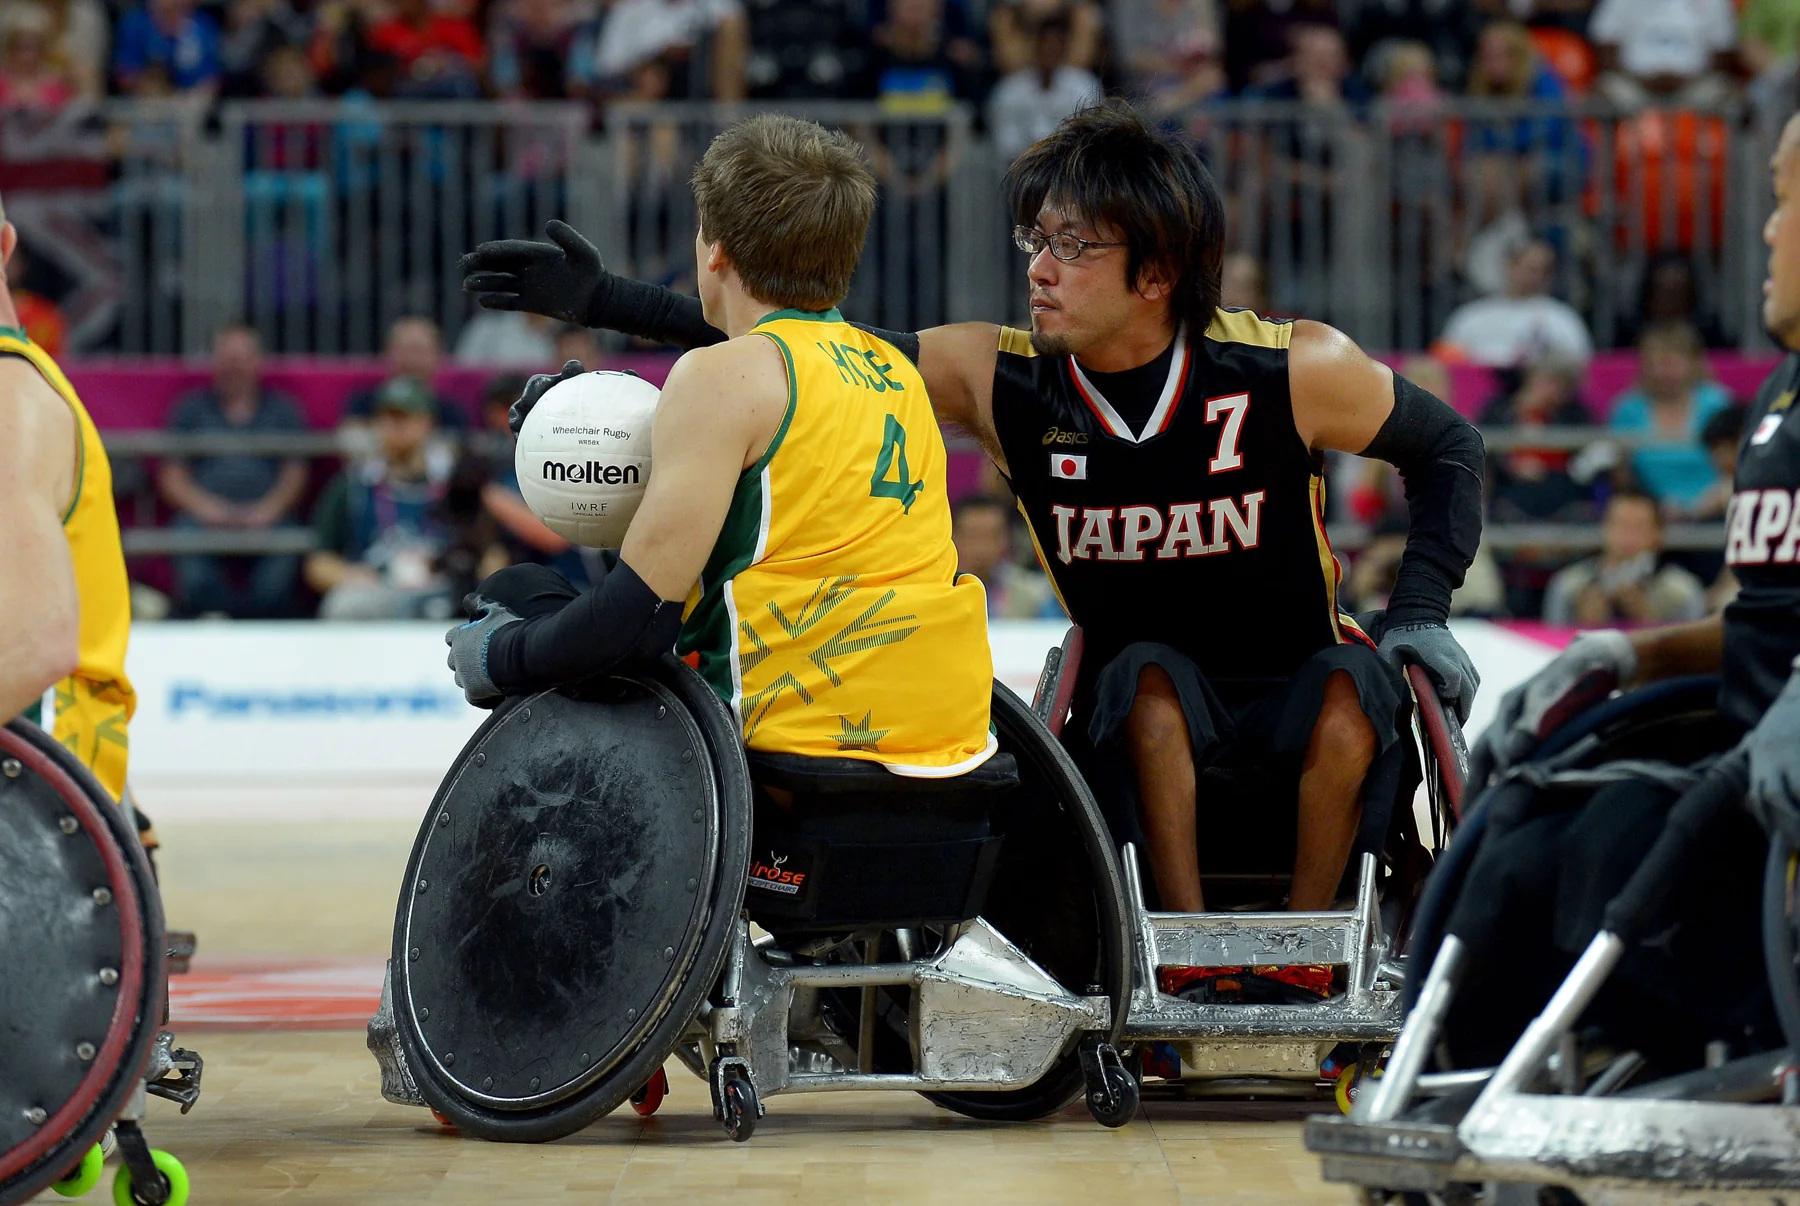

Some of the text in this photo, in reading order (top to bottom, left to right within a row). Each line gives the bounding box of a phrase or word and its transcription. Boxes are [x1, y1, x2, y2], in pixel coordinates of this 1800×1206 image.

[552, 426, 631, 440] Wheelchair Rugby
[1054, 429, 1089, 445] asics
[1204, 391, 1250, 475] 7
[543, 461, 639, 485] molten
[869, 413, 924, 515] 4
[1051, 490, 1266, 566] JAPAN
